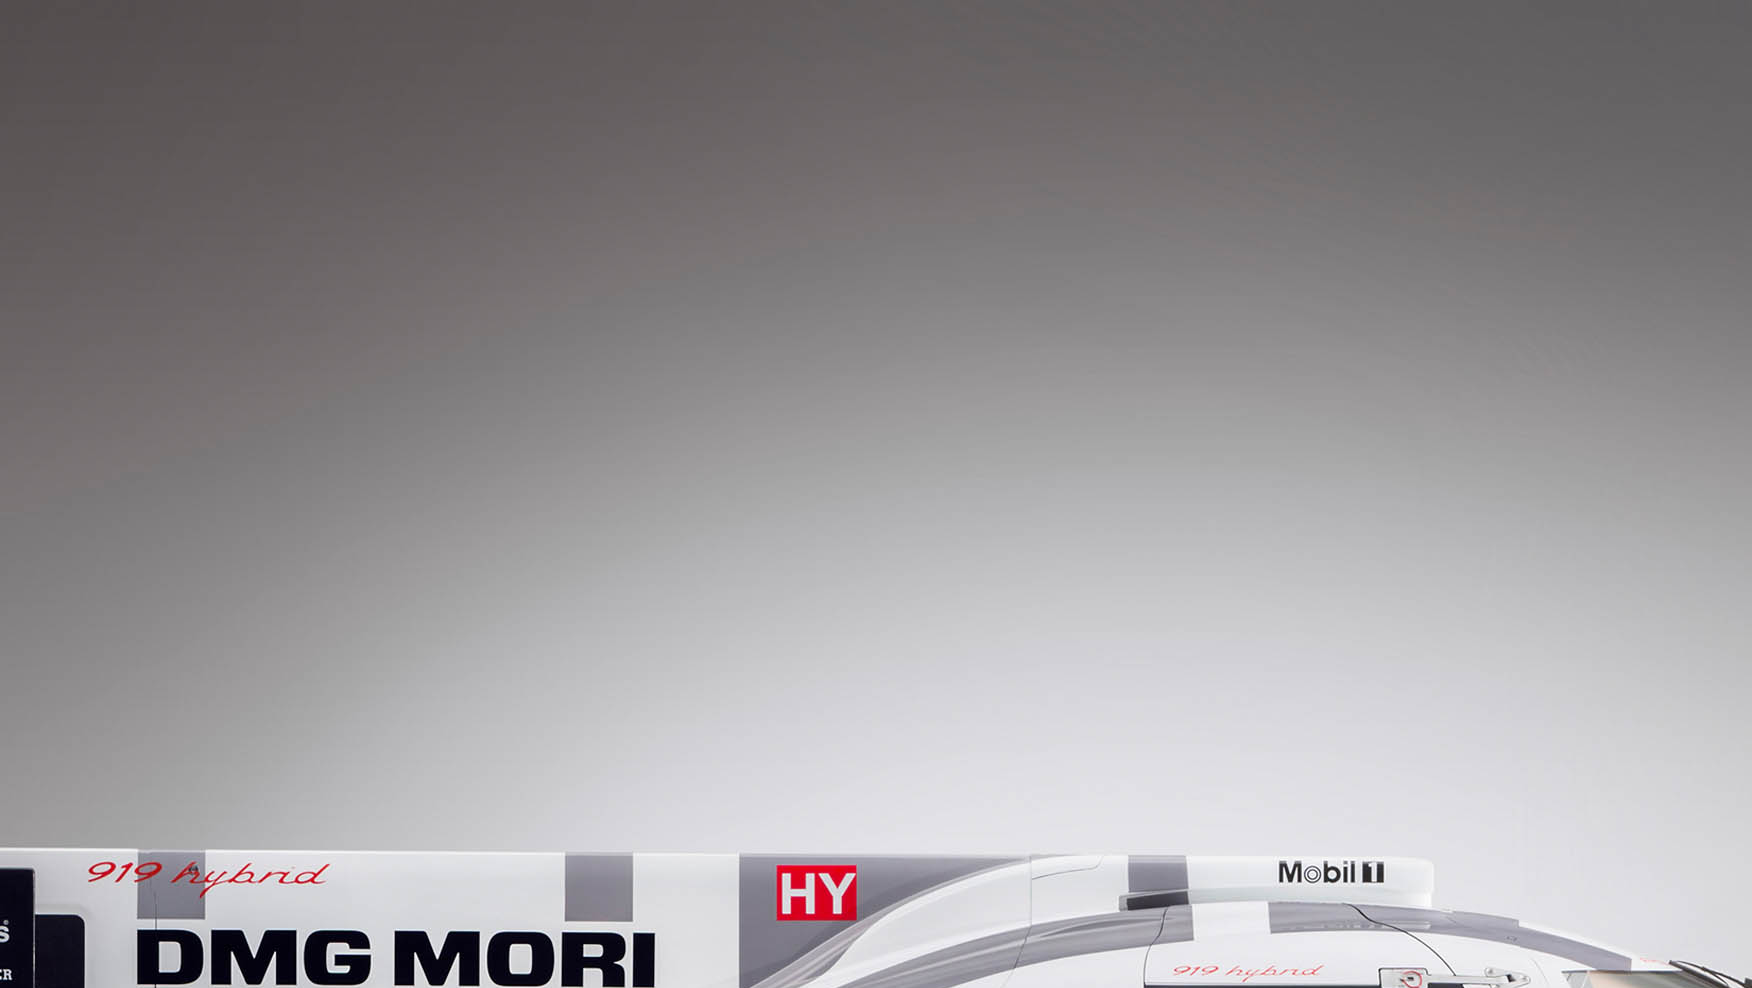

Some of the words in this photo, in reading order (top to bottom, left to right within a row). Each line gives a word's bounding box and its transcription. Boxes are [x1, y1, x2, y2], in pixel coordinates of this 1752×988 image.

[87, 861, 163, 883] 919
[170, 861, 331, 899] hybrid
[1278, 860, 1356, 883] Mobil
[781, 872, 856, 915] HY
[135, 929, 372, 985] DMG
[393, 930, 656, 988] MORI
[1172, 965, 1219, 977] 919
[1225, 964, 1325, 982] hybrid
